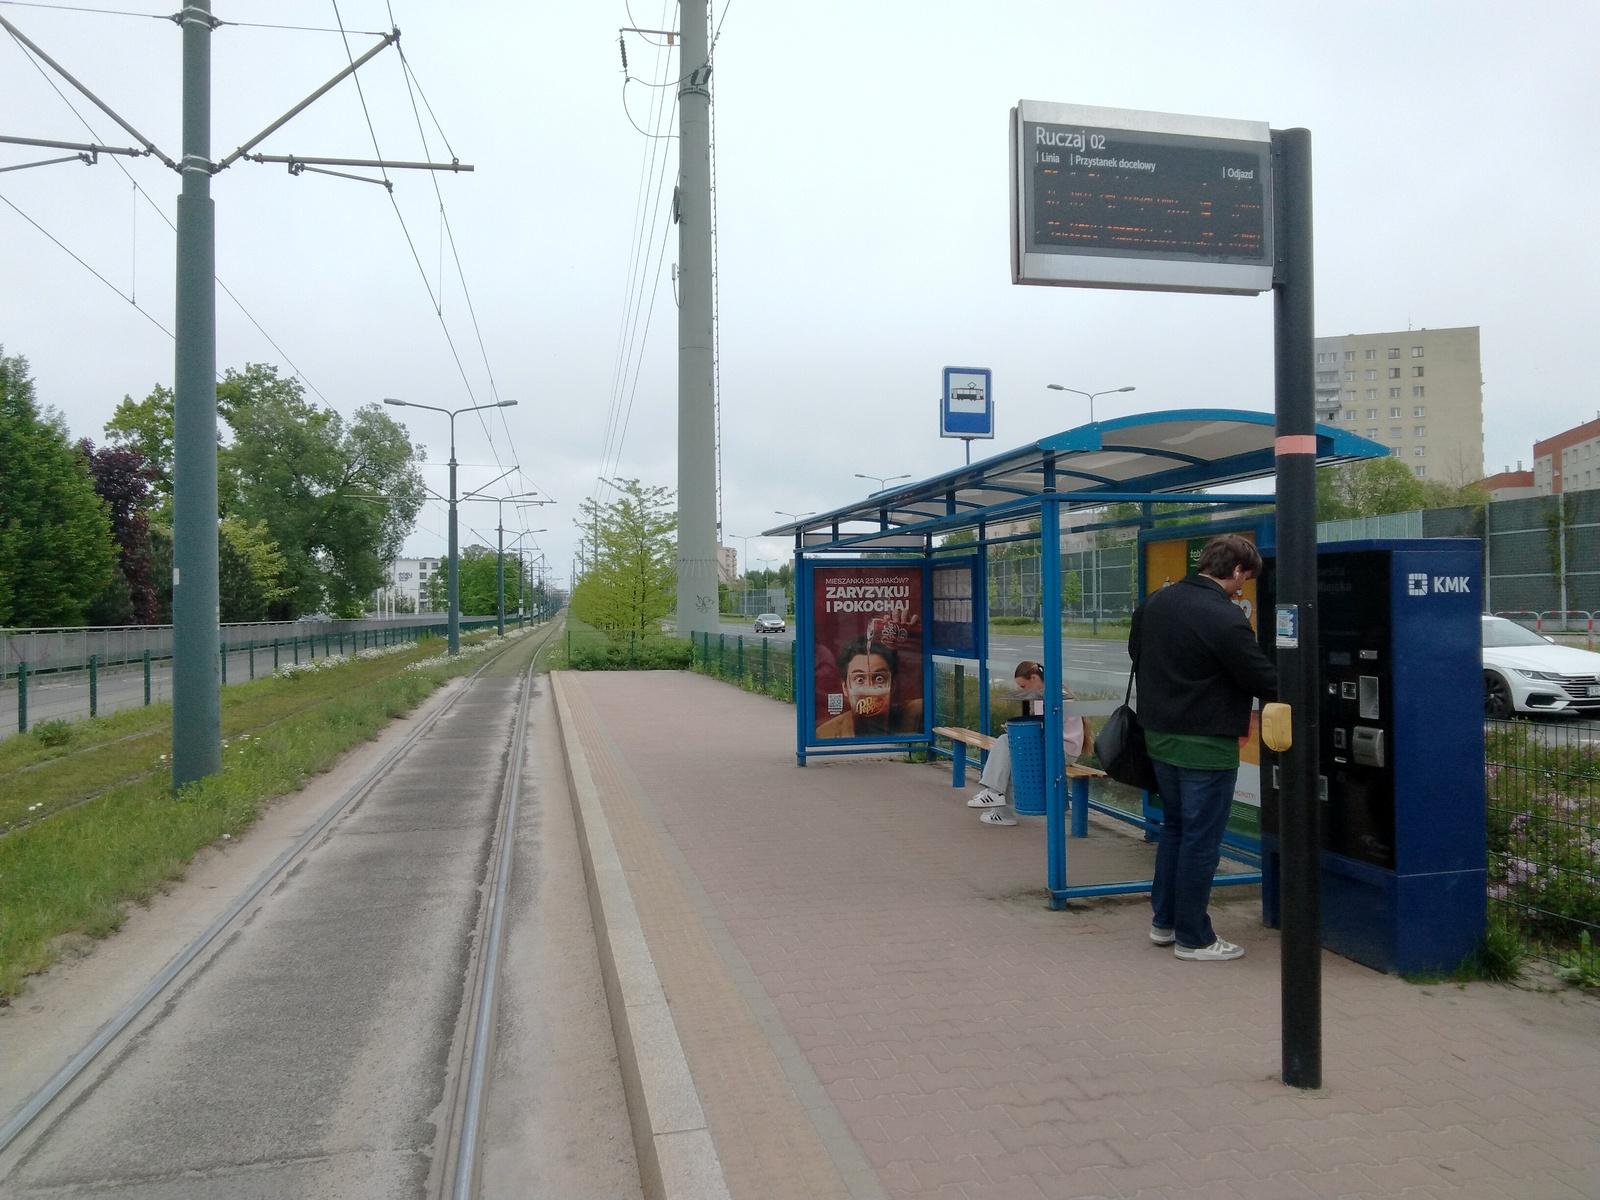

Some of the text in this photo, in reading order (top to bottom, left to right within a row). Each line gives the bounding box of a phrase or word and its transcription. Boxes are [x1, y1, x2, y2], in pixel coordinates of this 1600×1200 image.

[1036, 126, 1106, 153] Ruczaj 02
[1041, 151, 1060, 163] Linia
[1075, 154, 1156, 173] Przystanek docelowy
[1227, 167, 1254, 181] Odjazd
[825, 577, 865, 585] MIESZANKA
[875, 575, 909, 584] SMAKÓW?
[1433, 576, 1471, 593] KMK
[825, 586, 910, 599] ZARYZYKUJ
[826, 599, 910, 613] I POKOCHAJ
